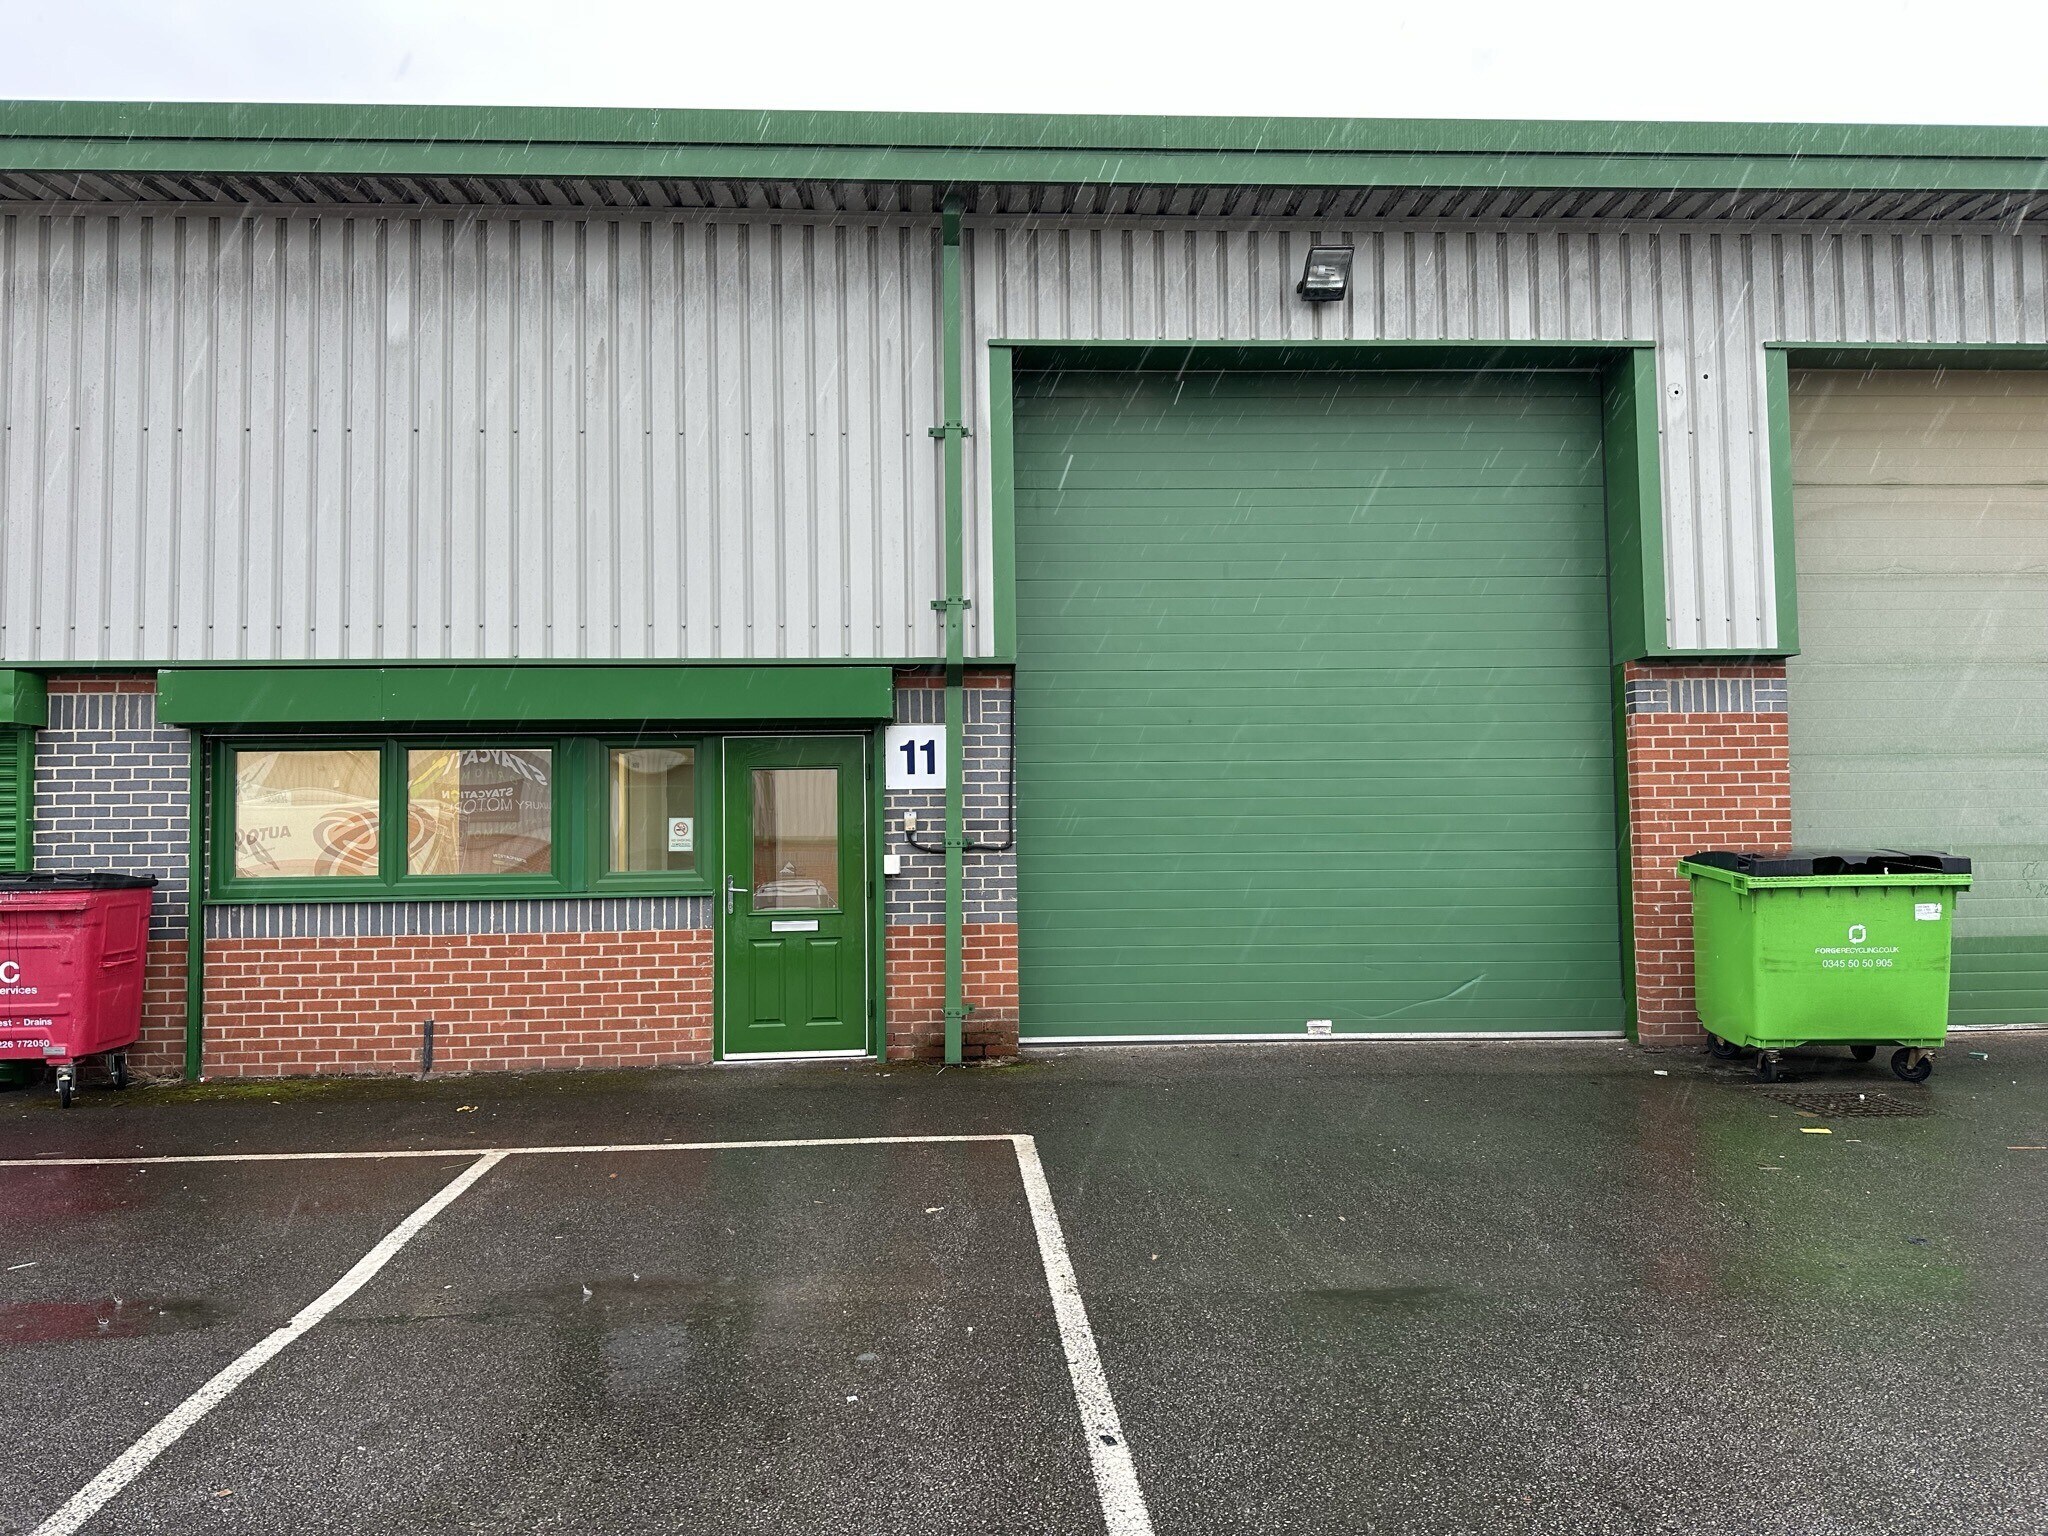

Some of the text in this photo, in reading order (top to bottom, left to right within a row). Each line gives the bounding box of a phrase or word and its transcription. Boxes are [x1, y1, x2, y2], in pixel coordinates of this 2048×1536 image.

[900, 740, 935, 775] 11
[1815, 946, 1899, 954] FORGERECYCLING.CO.UK
[1822, 959, 1893, 967] 0345 50 50 905
[24, 1018, 52, 1026] Drains
[17, 1039, 50, 1048] 772050
